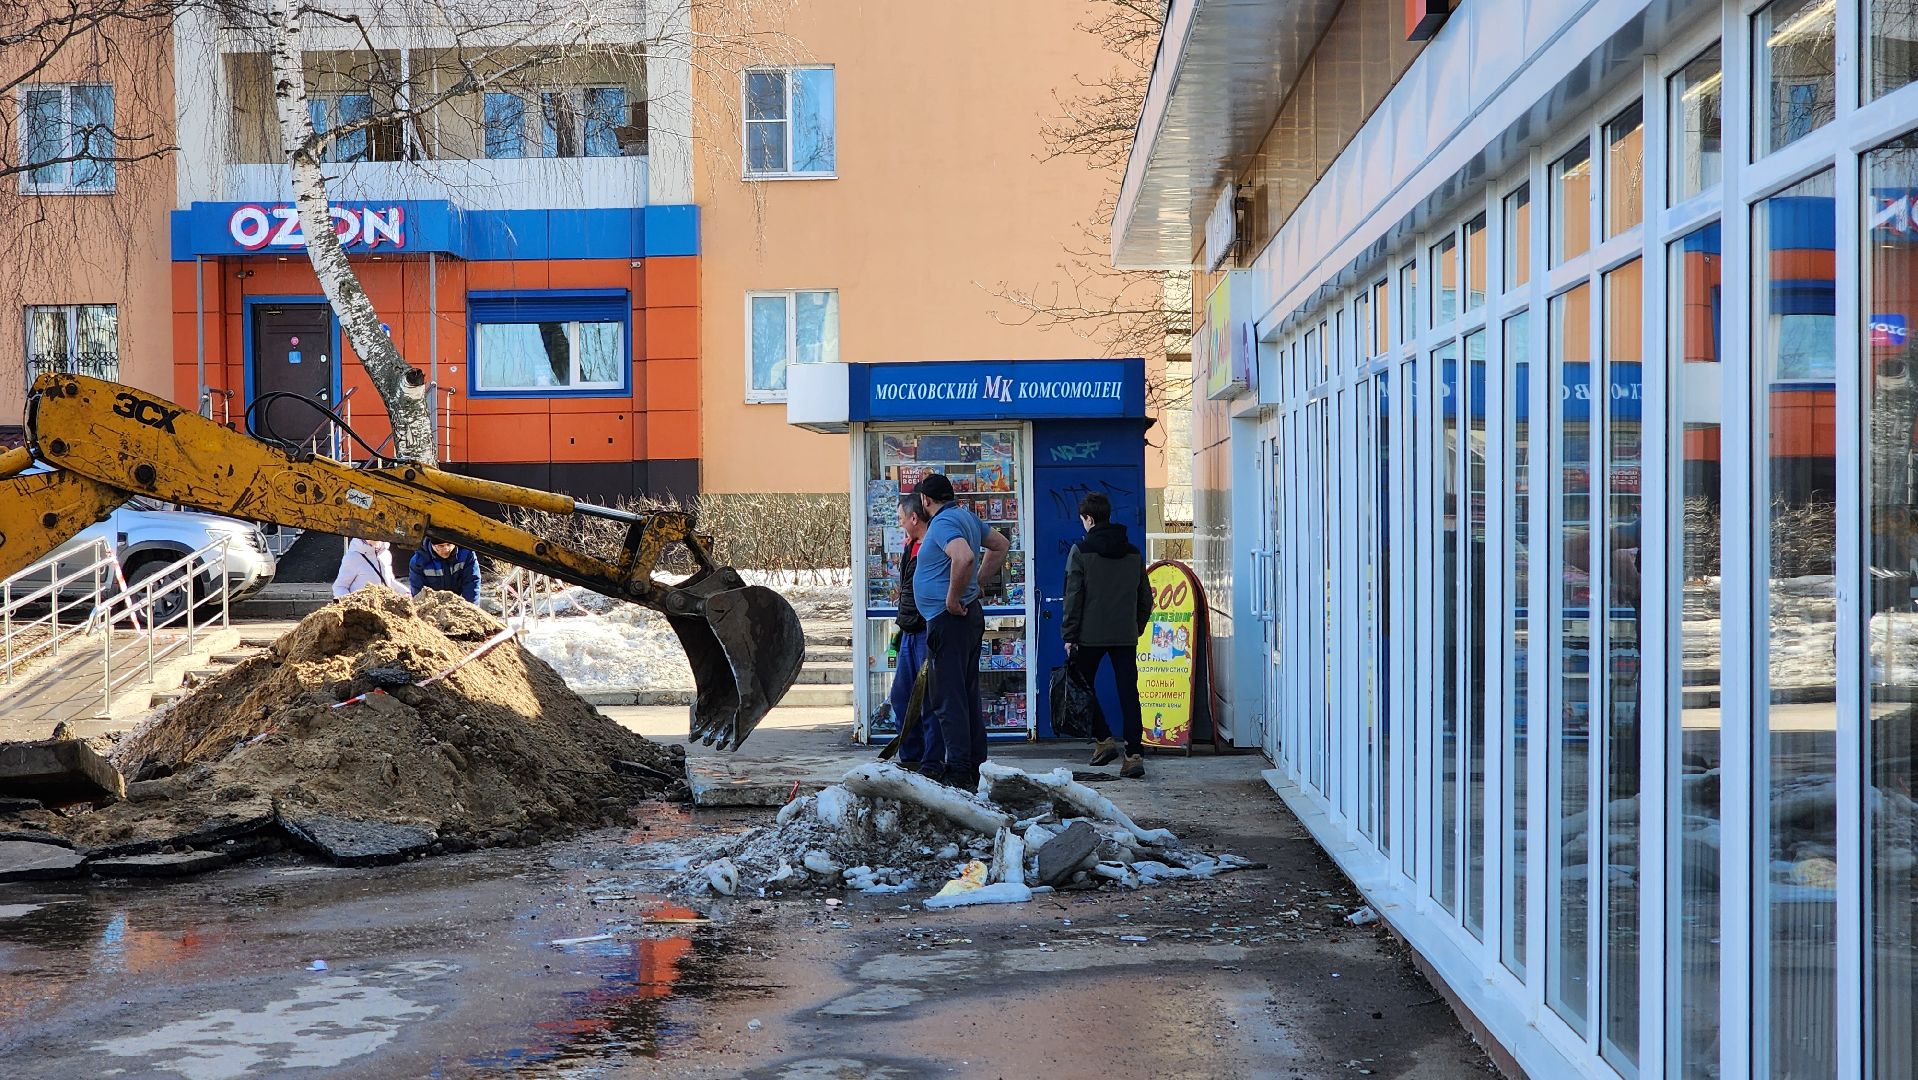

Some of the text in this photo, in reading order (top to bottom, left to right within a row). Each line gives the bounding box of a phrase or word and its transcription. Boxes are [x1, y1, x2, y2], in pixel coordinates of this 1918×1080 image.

[875, 375, 1123, 402] МОСКОВСКИЙ МК КОМСОМОЛЕЦ
[113, 392, 181, 435] 3CX
[1139, 691, 1186, 700] ССОРТИМЕНТ
